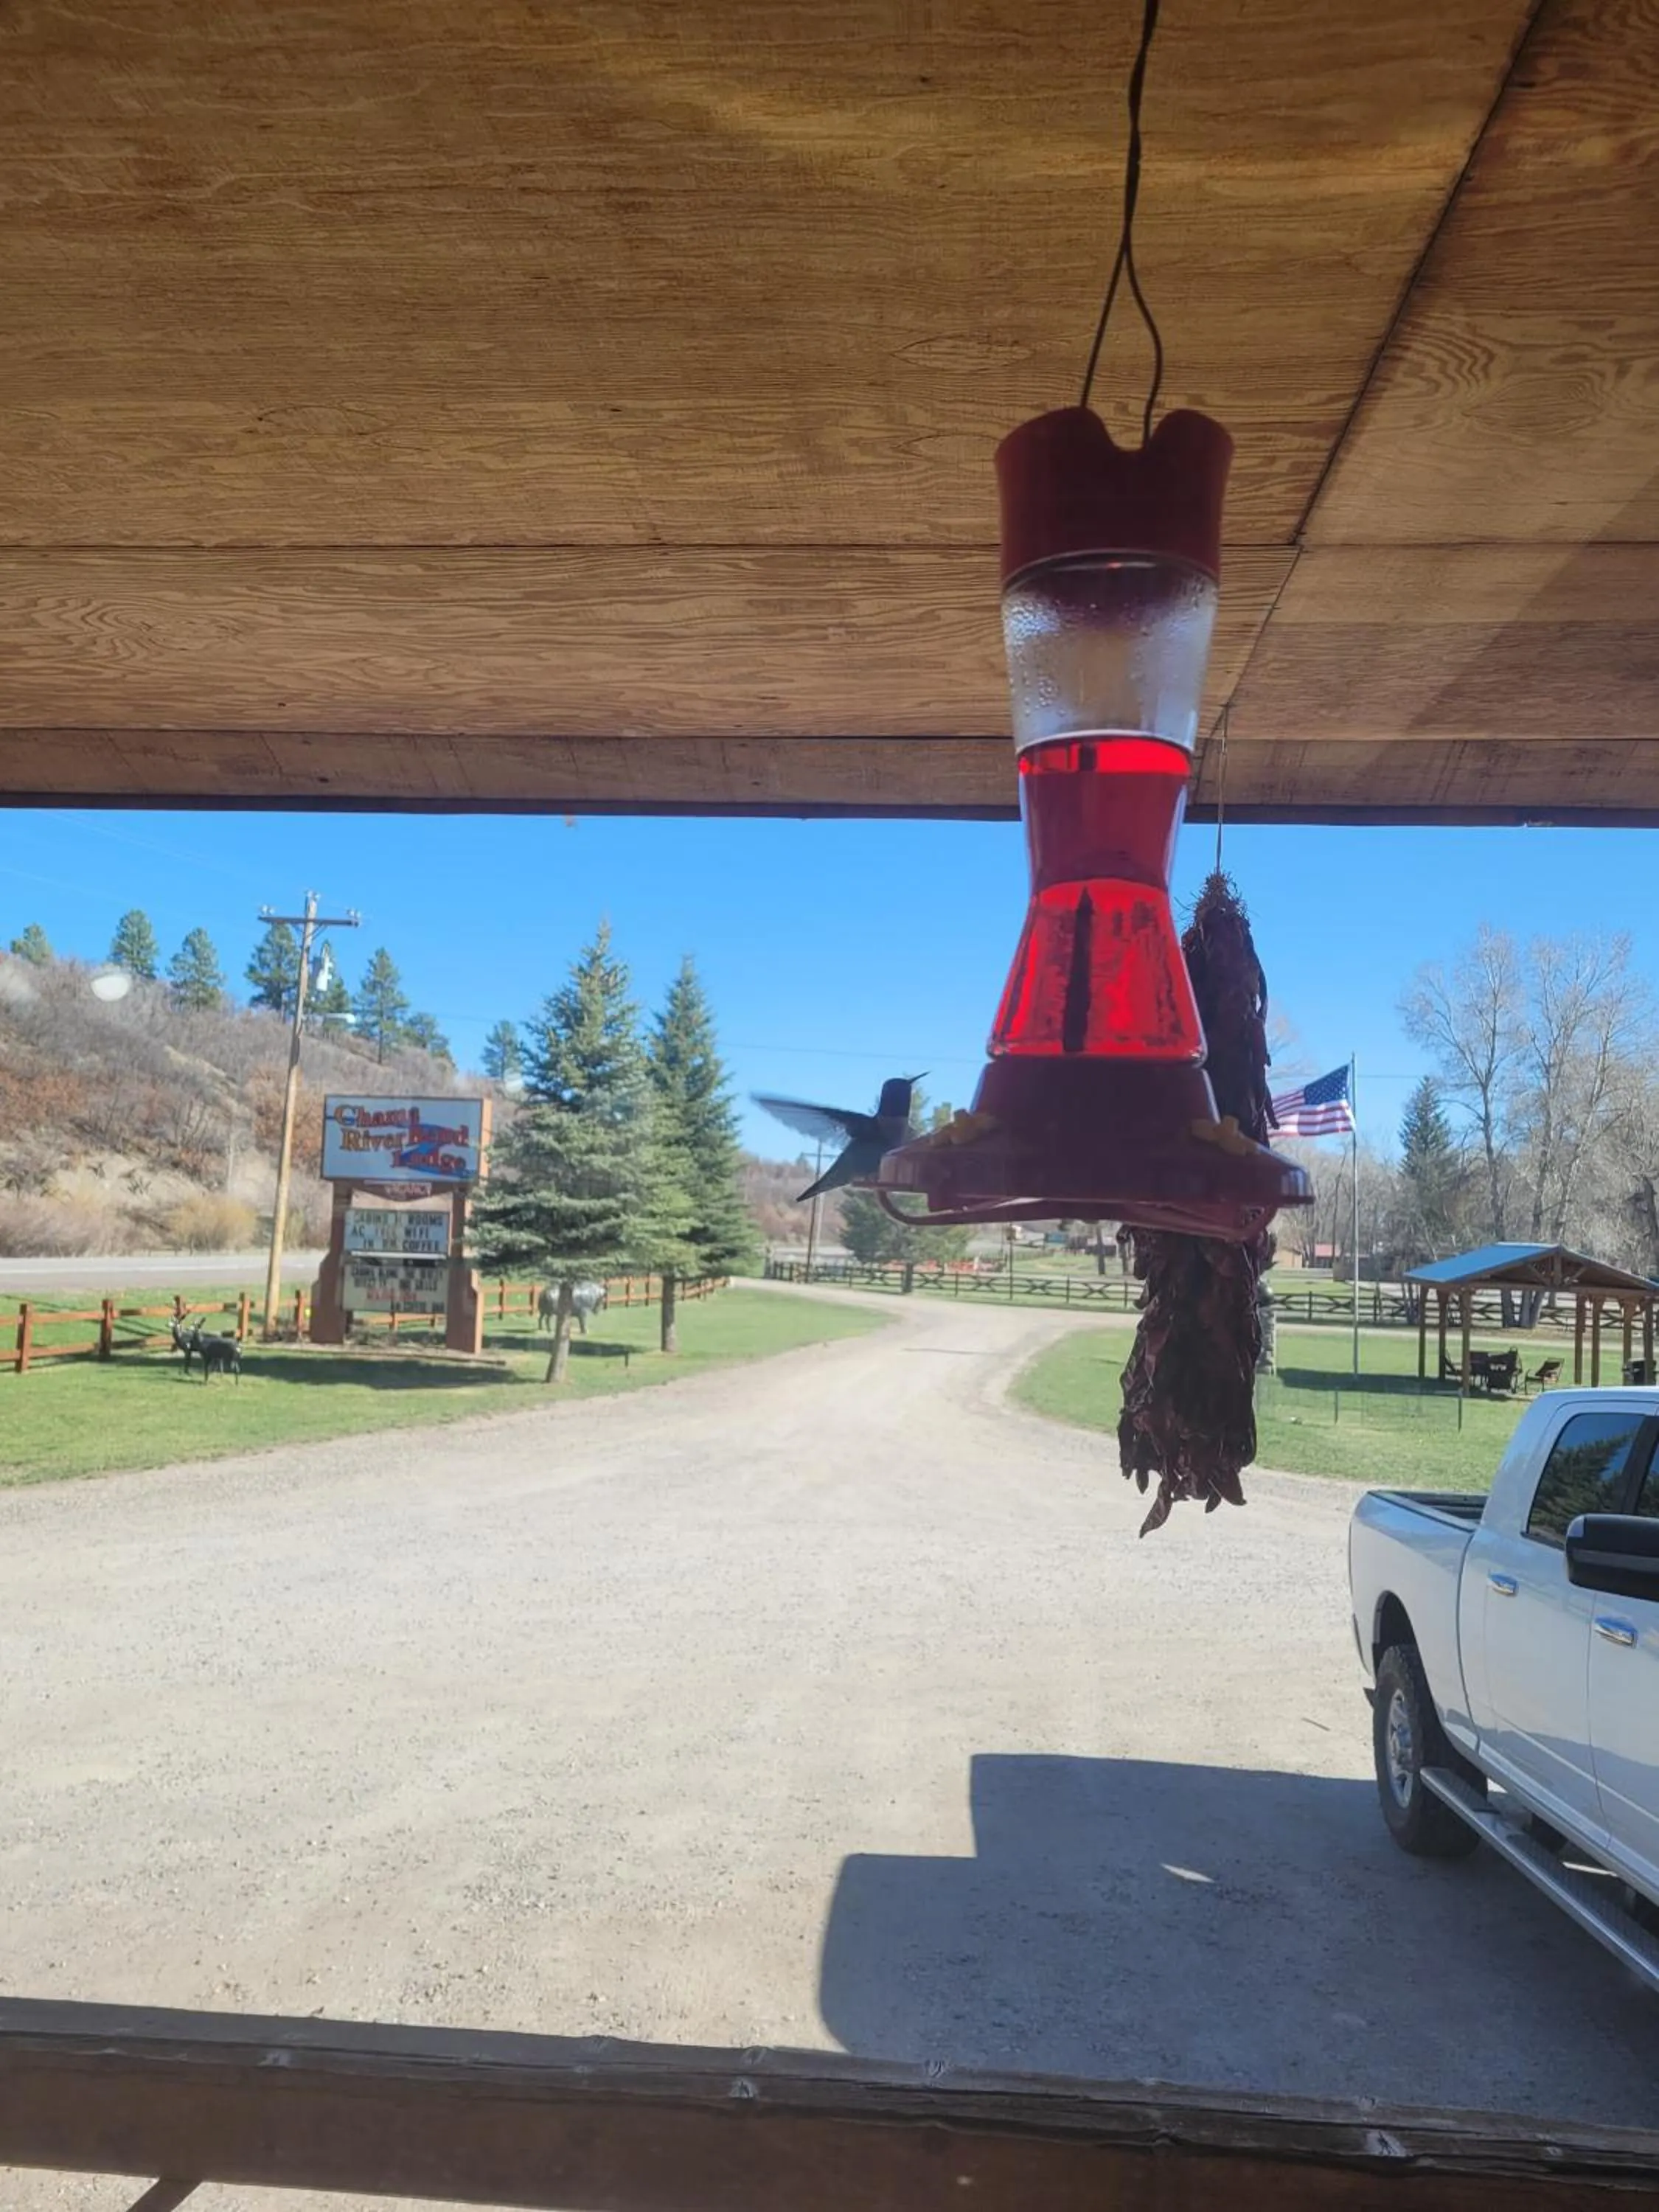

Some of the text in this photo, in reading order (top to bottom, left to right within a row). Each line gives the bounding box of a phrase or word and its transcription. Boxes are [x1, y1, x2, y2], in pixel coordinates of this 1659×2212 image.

[340, 1124, 469, 1152] River Bend
[390, 1149, 467, 1175] Lodge
[407, 1213, 444, 1226] ROOMS
[352, 1225, 366, 1238] AC
[402, 1239, 439, 1252] COFFEE
